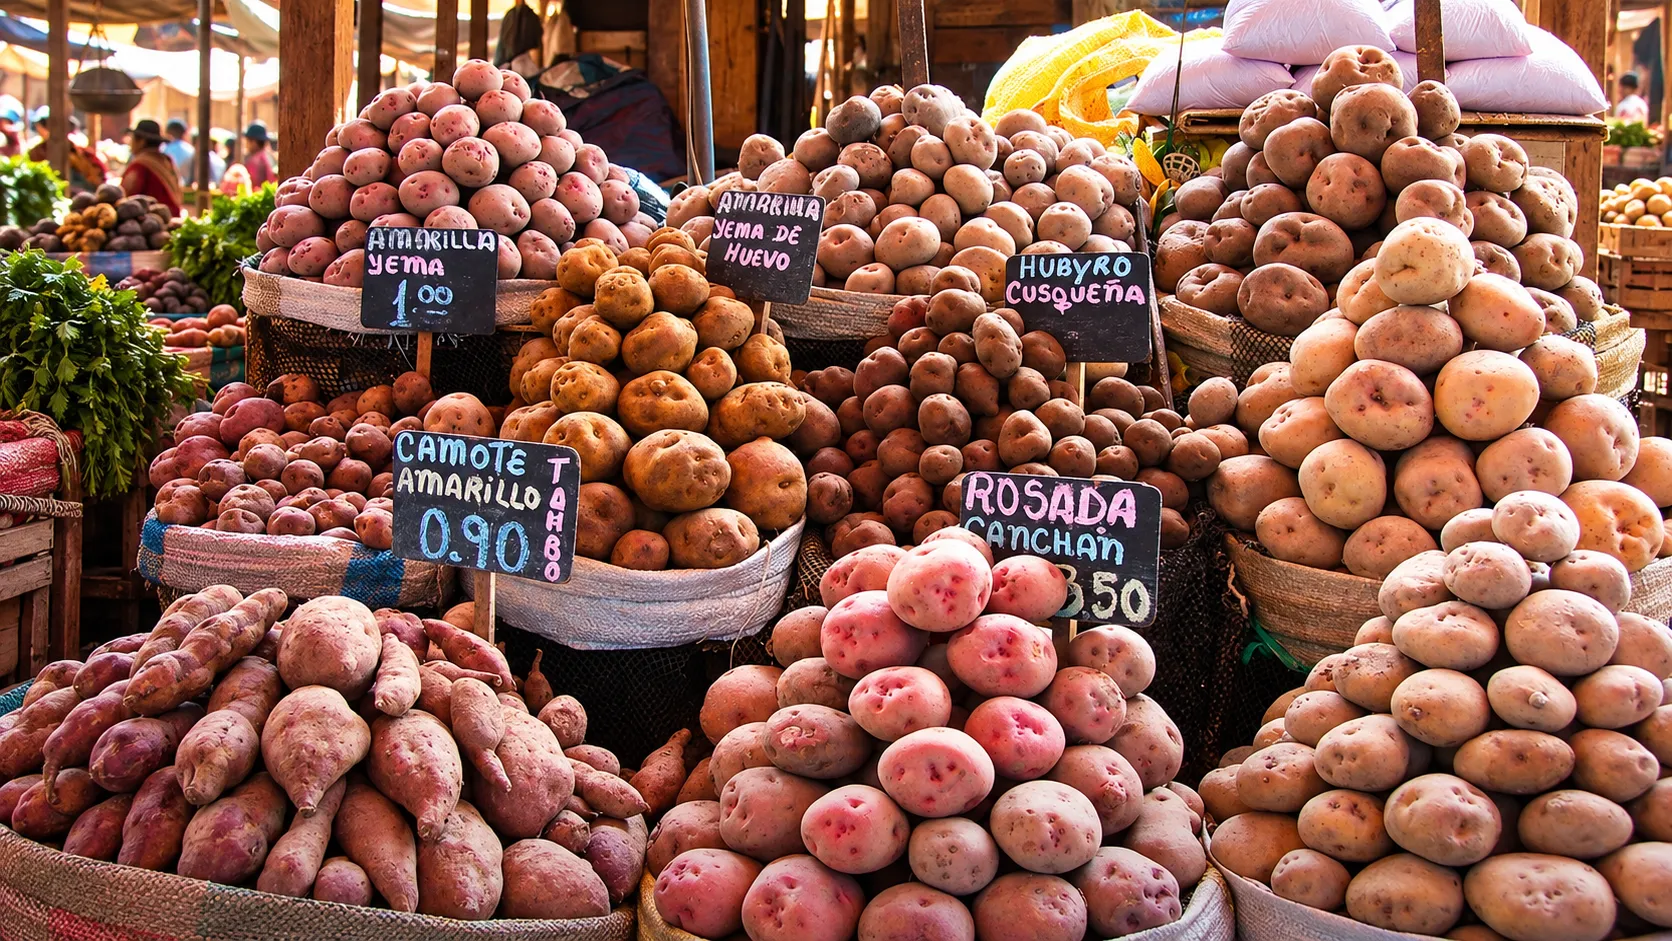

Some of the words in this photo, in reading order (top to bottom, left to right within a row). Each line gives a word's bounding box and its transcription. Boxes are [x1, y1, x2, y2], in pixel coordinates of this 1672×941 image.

[712, 218, 765, 240] YEMA
[772, 225, 803, 245] DE
[368, 253, 445, 276] YEMA
[724, 242, 791, 271] HUEVO
[1020, 255, 1132, 285] HUBYRO
[1005, 279, 1146, 315] CUSQUEÑA
[396, 432, 528, 476] CAMOTE
[397, 467, 542, 511] AMARILLO
[965, 472, 1137, 529] ROSADA
[420, 508, 530, 573] 0.90
